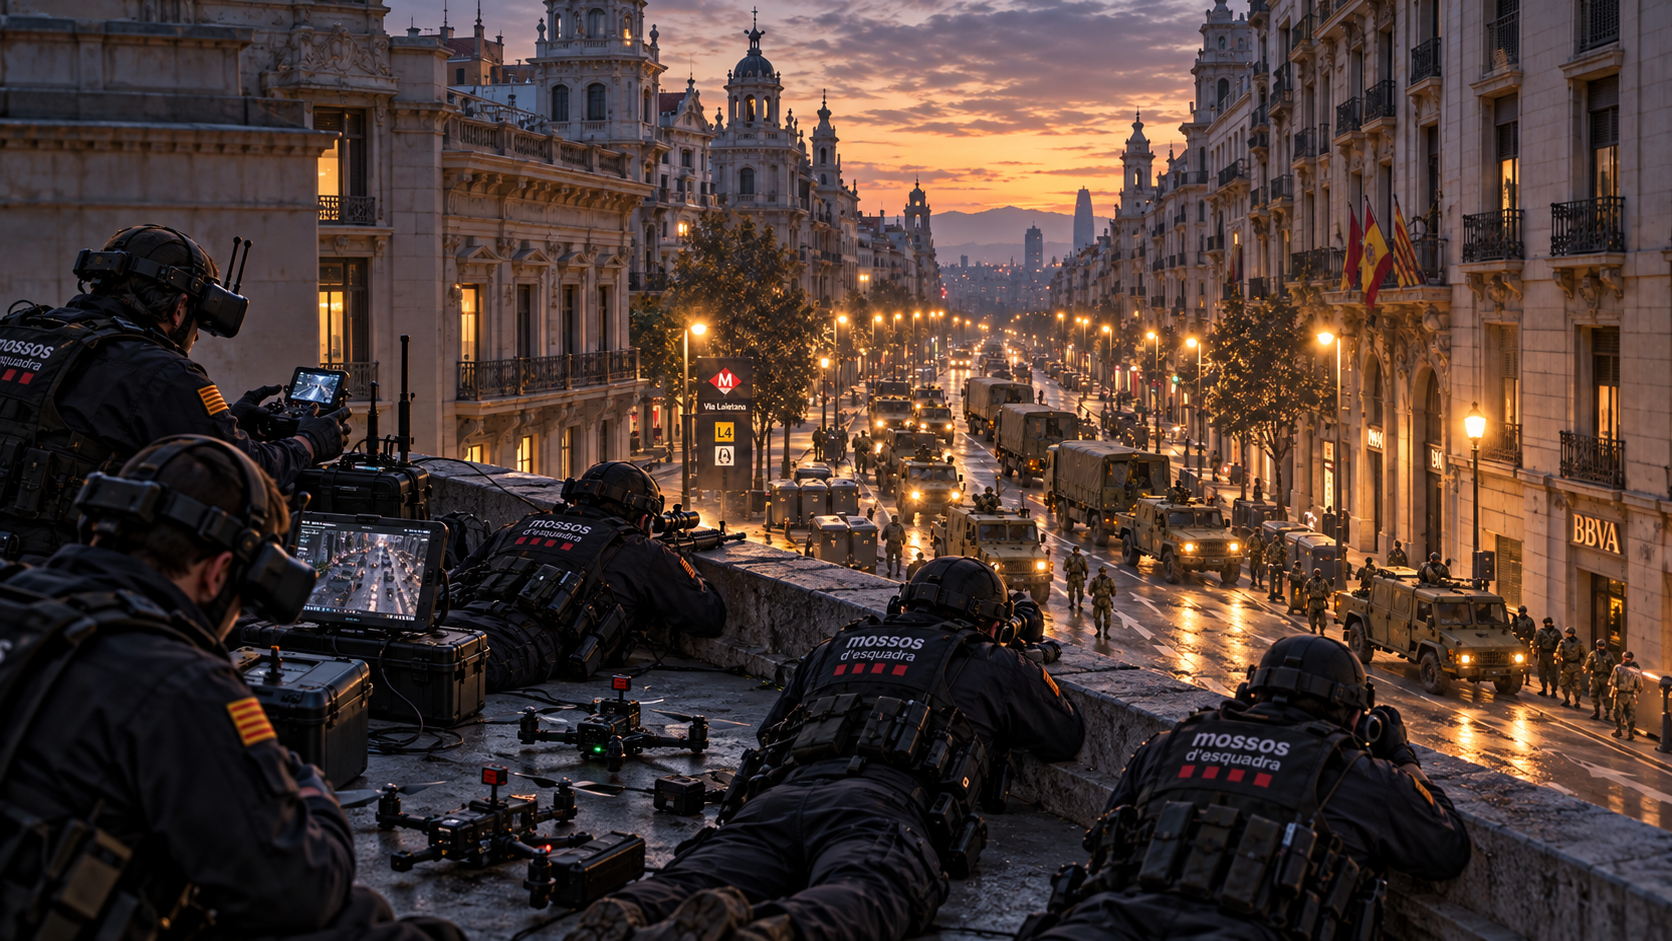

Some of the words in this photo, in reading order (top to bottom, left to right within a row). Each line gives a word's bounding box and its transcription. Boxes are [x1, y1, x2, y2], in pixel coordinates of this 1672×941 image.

[718, 372, 733, 387] M
[703, 402, 716, 411] Via
[718, 426, 732, 439] L4
[528, 519, 592, 535] mossos
[1573, 513, 1620, 554] BBVA
[845, 635, 925, 650] mossos
[840, 649, 916, 662] d'esquadra
[1191, 732, 1291, 756] mossos
[1185, 748, 1281, 771] d'esquadra
